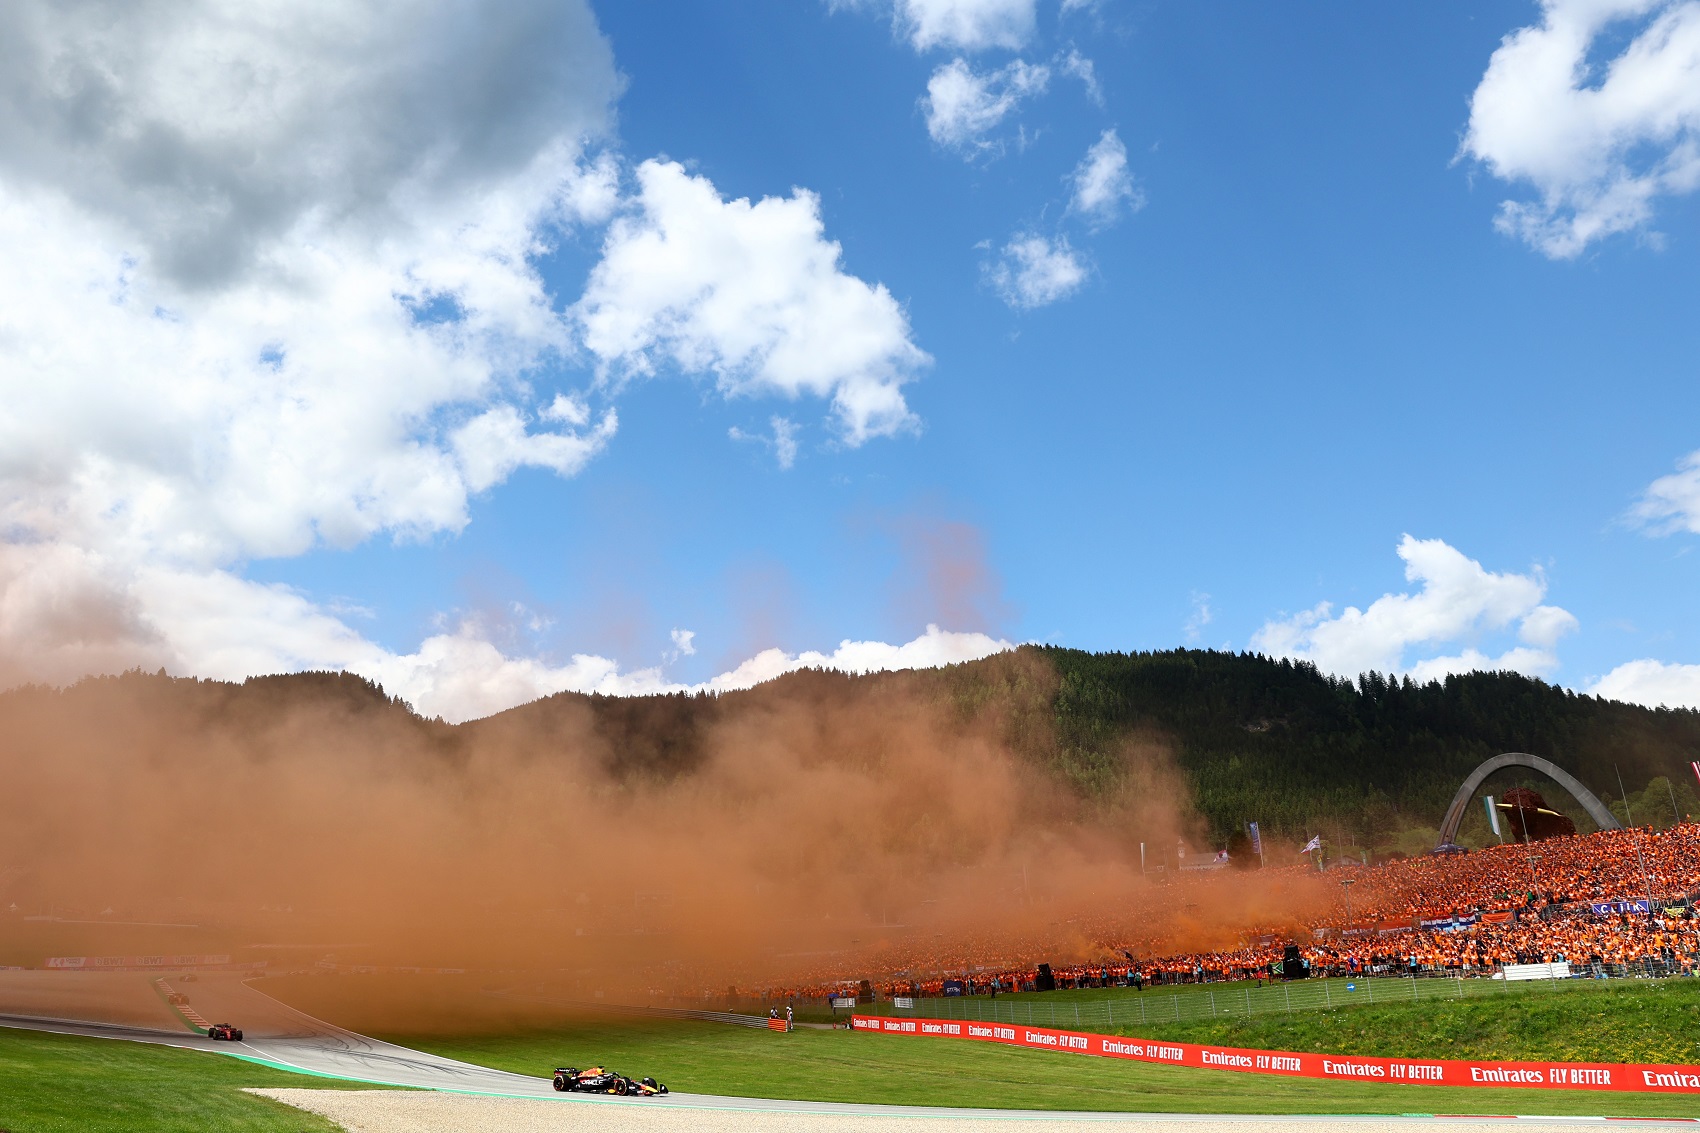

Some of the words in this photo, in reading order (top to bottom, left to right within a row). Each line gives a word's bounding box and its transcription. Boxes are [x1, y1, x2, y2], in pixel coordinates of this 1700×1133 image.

[103, 957, 124, 966] BWT
[143, 956, 163, 965] BWT
[180, 955, 197, 964] BWT
[854, 1018, 867, 1028] Emirates
[884, 1021, 900, 1031] Emirates
[922, 1023, 942, 1034] Emirates
[949, 1024, 961, 1035] BETTER
[968, 1025, 993, 1038] Emirates
[1001, 1027, 1015, 1040] BETTER
[1025, 1030, 1058, 1046] Emirates
[1059, 1034, 1069, 1047] FLY
[1069, 1035, 1088, 1050] BETTER
[1102, 1039, 1144, 1056] Emirates
[1146, 1044, 1158, 1058] FLY
[1159, 1046, 1184, 1061] BETTER
[1201, 1050, 1253, 1068] Emirates
[1256, 1055, 1269, 1069] FLY
[1271, 1056, 1301, 1072] BETTER
[1322, 1060, 1385, 1077] Emirates
[1390, 1063, 1406, 1078] FLY
[1408, 1064, 1444, 1080] BETTER
[1470, 1066, 1544, 1083] Emirates
[1549, 1068, 1568, 1084] FLY
[1570, 1068, 1612, 1085] BETTER
[1641, 1070, 1700, 1088] Emira
